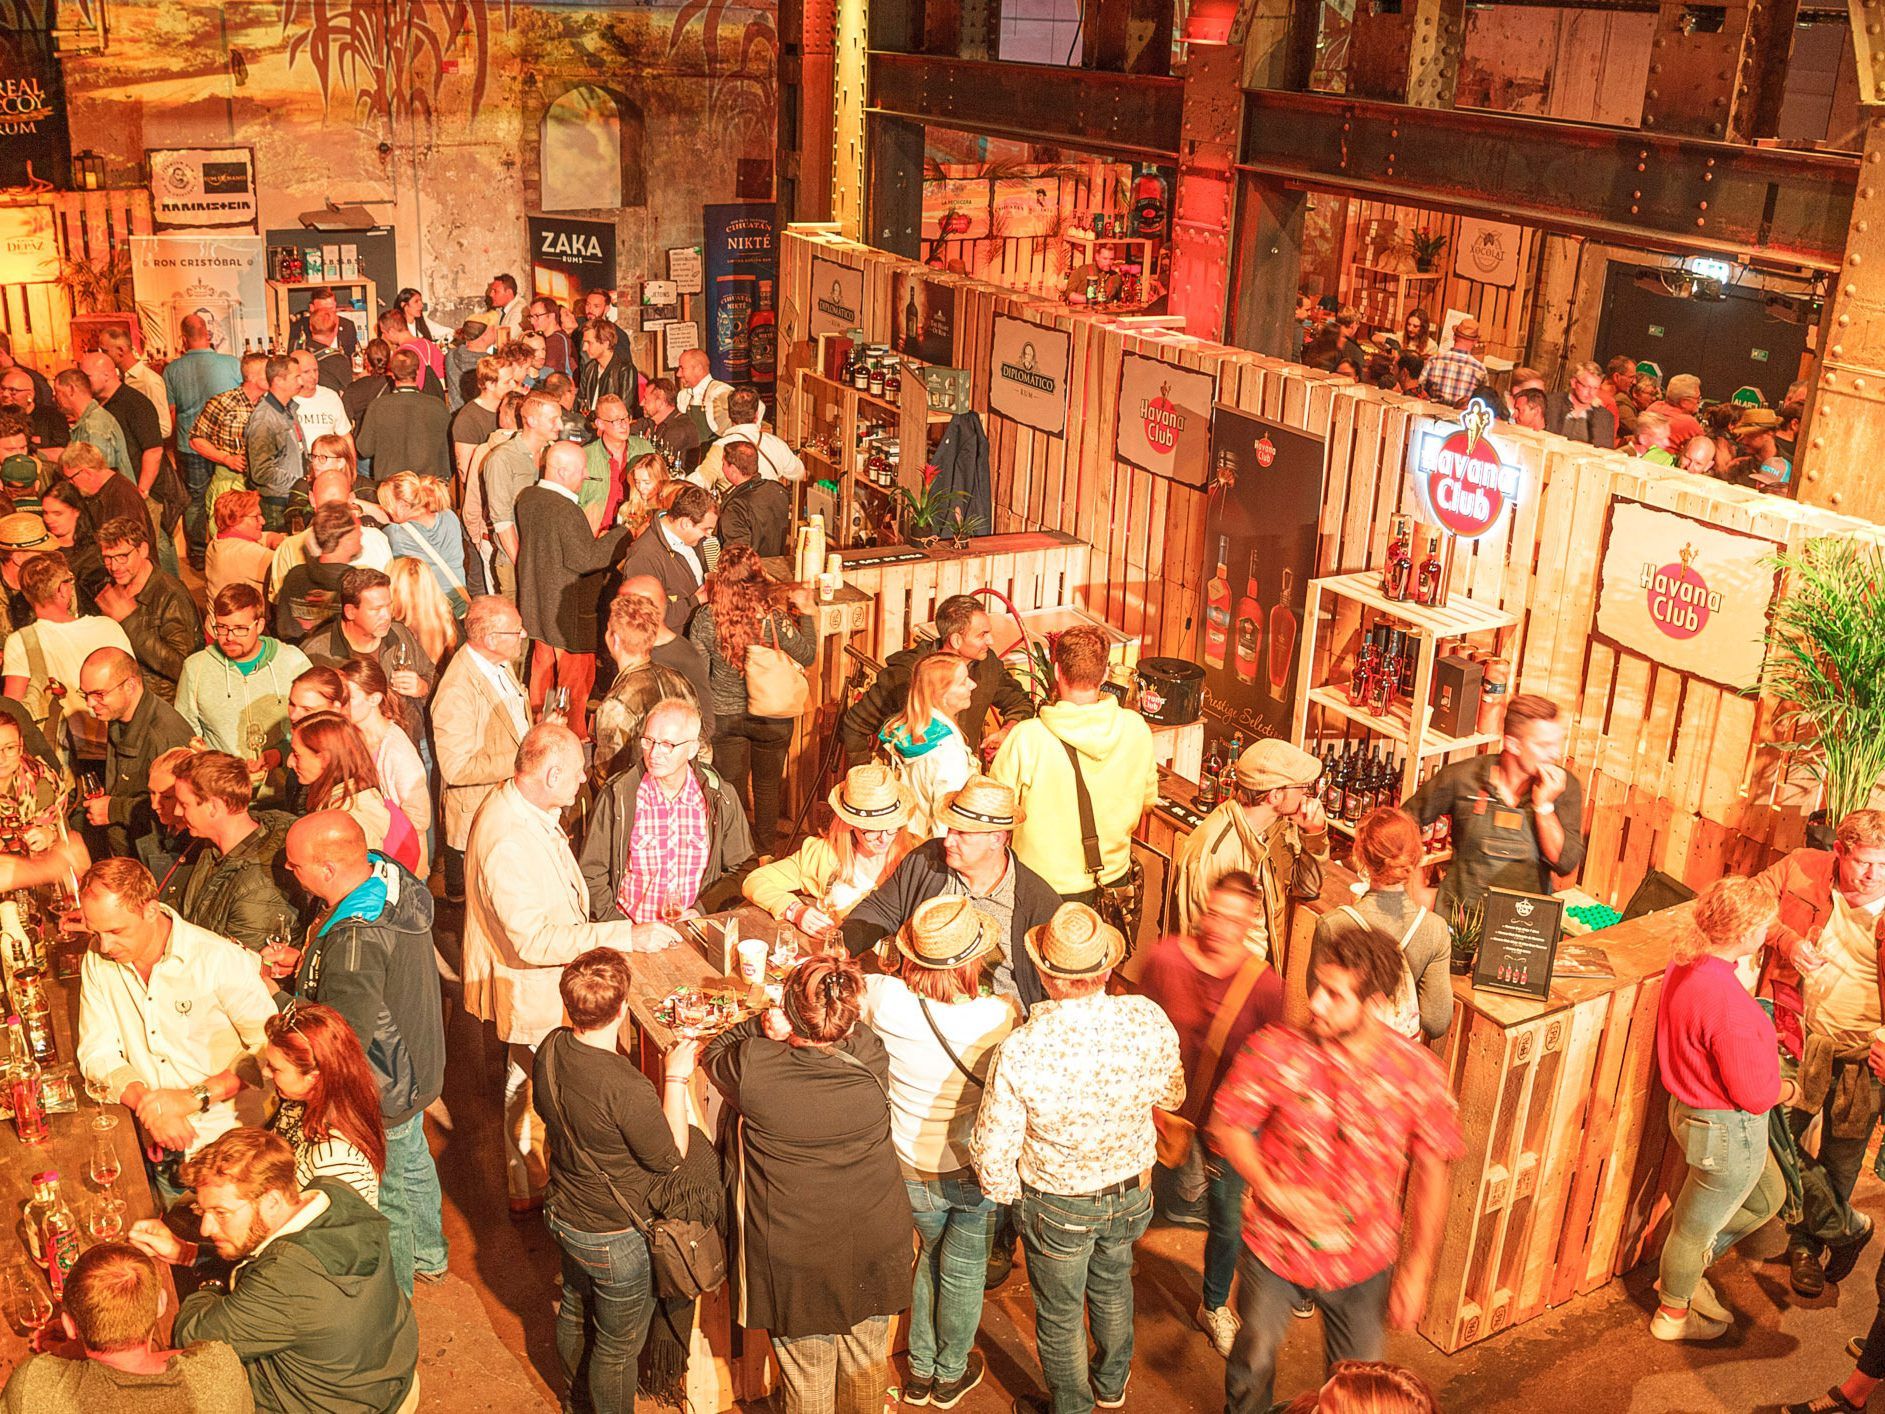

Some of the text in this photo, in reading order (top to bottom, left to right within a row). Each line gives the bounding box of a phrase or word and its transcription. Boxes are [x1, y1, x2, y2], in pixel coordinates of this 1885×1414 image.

[541, 231, 603, 257] ZAKA
[727, 234, 772, 250] NIKTÉ
[153, 257, 243, 267] RON CRISTÓBAL
[562, 255, 583, 264] RUMS
[1139, 398, 1186, 432] Havana
[1147, 422, 1174, 448] Club
[1436, 476, 1491, 523] Club
[1640, 562, 1723, 613] Havana
[1653, 595, 1699, 632] Club
[1203, 686, 1238, 726] Prestige
